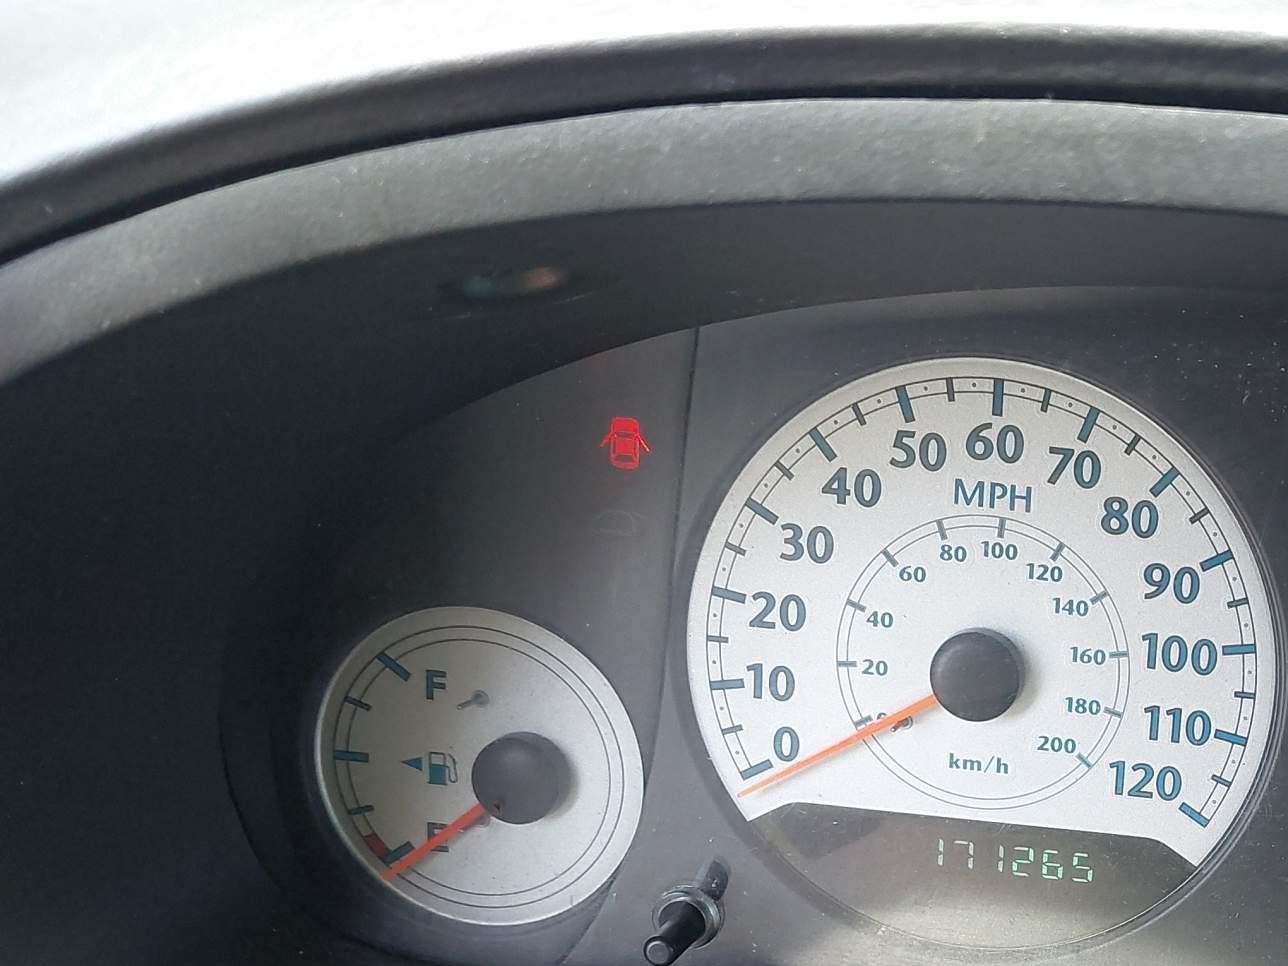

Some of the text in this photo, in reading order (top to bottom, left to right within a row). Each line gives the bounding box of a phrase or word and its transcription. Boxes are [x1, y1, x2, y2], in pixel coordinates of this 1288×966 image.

[890, 430, 946, 472] 50
[965, 424, 1023, 463] 60
[1048, 446, 1100, 488] 70
[822, 467, 881, 507] 40
[953, 479, 1032, 513] MPH
[1101, 496, 1158, 538] 80
[780, 523, 833, 564] 30
[939, 543, 967, 563] 80
[981, 540, 1018, 561] 100
[900, 565, 926, 584] 60
[1026, 561, 1062, 583] 120
[1143, 563, 1200, 604] 90
[749, 593, 806, 631] 20
[867, 609, 894, 629] 40
[1053, 595, 1089, 617] 140
[862, 657, 888, 678] 20
[1070, 643, 1106, 666] 160
[1142, 632, 1218, 676] 100
[426, 670, 446, 699] F
[746, 663, 795, 701] 10
[1065, 695, 1101, 716] 180
[774, 726, 799, 761] 0
[1145, 706, 1212, 746] 110
[1037, 734, 1076, 754] 200
[949, 752, 1009, 774] km/h
[1110, 760, 1182, 800] 120
[937, 838, 1094, 883] 171265
